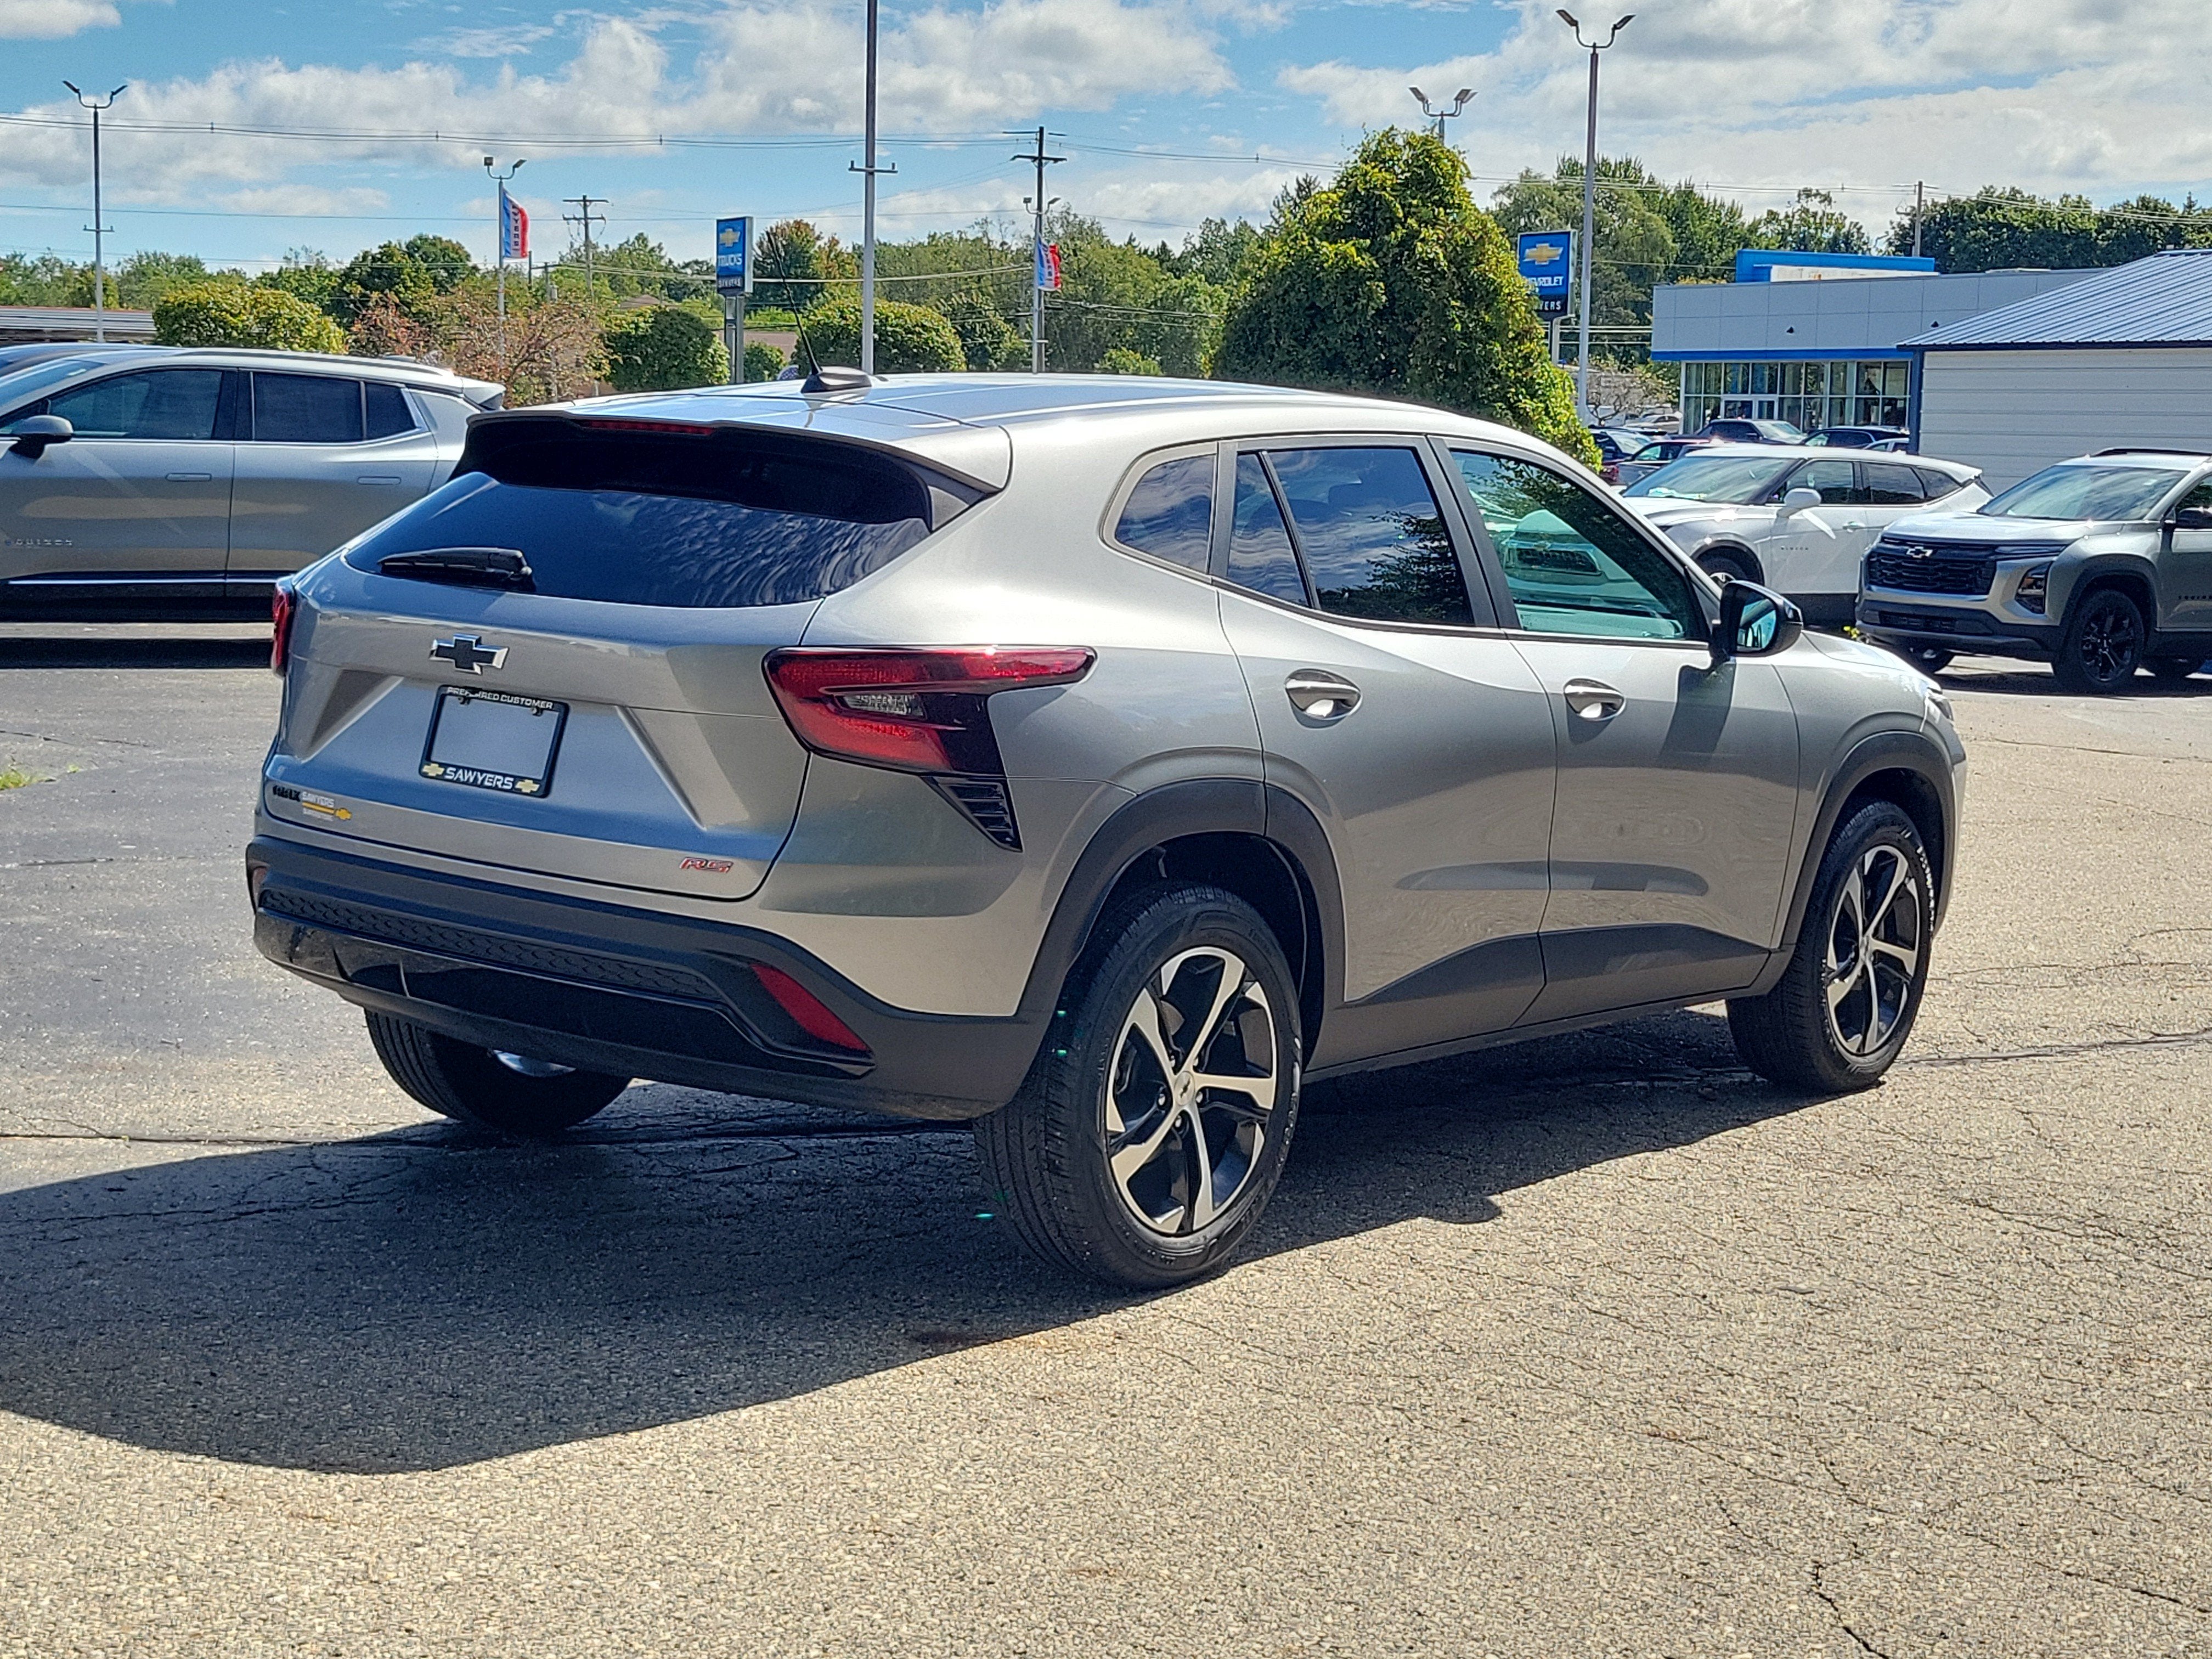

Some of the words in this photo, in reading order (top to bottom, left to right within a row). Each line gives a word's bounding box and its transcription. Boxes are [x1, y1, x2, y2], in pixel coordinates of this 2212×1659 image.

[1539, 301, 1561, 311] YERS
[500, 694, 553, 709] CUSTOMER
[445, 767, 514, 789] SAWYERS
[679, 856, 734, 873] RS
